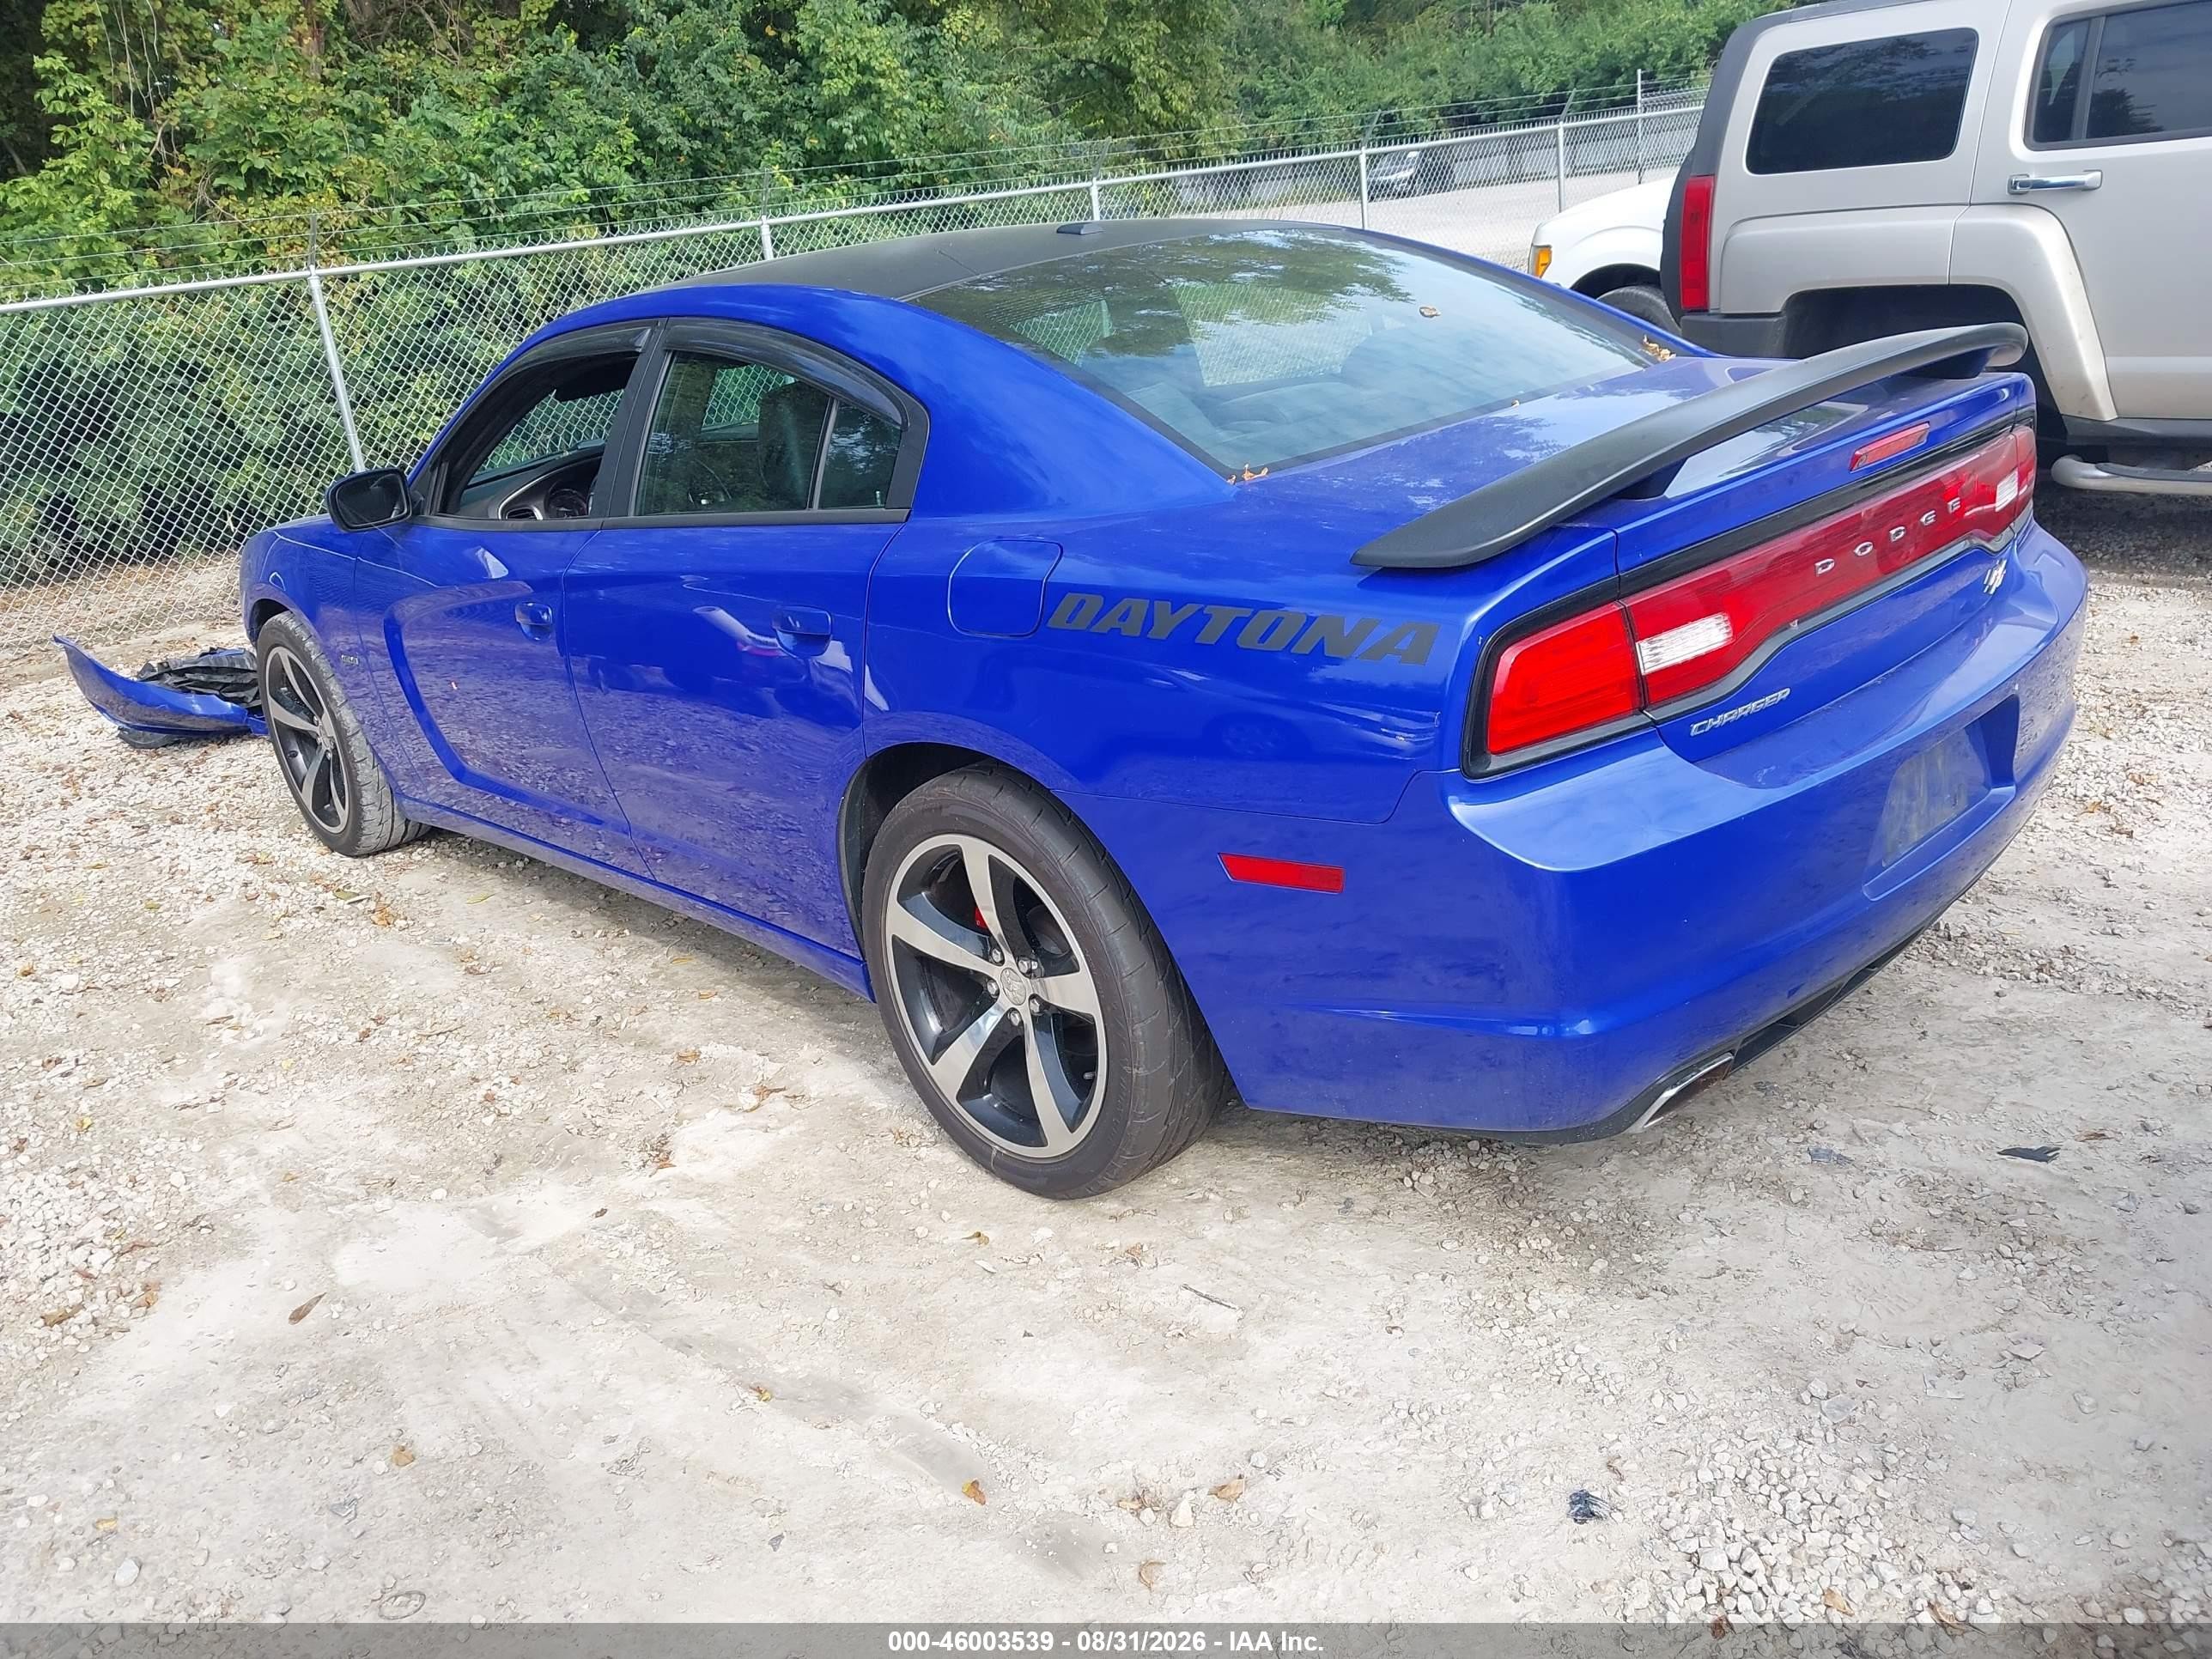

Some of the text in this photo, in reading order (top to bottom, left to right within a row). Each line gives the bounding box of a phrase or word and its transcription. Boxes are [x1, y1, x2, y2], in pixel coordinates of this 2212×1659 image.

[1814, 497, 1961, 576] DODGE
[1047, 592, 1442, 665] DAYTONA
[1690, 688, 1791, 736] CHARGER
